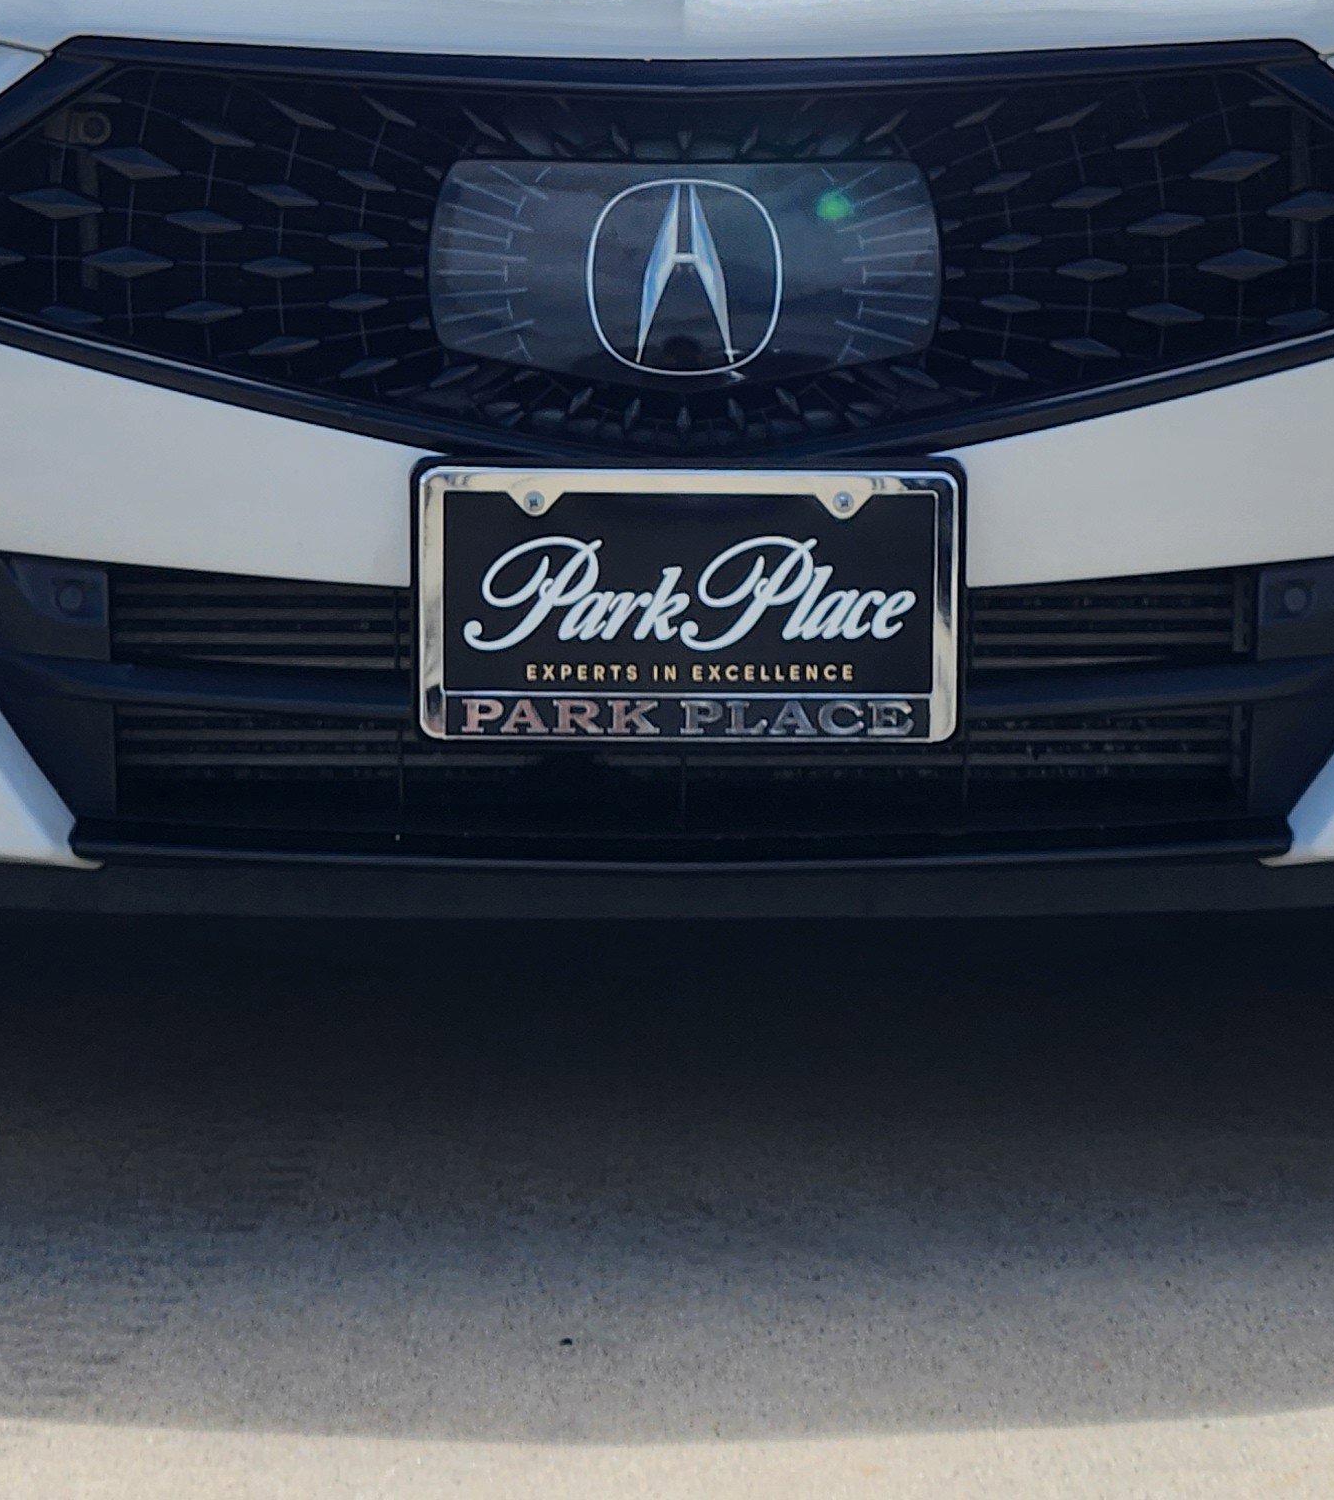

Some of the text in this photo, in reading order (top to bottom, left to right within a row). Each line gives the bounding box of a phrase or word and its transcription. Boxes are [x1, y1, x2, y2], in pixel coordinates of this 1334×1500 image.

[464, 535, 917, 651] Park Place
[526, 664, 854, 682] EXPERTS IN EXCELLENCE
[461, 699, 914, 736] PARK PLACE
